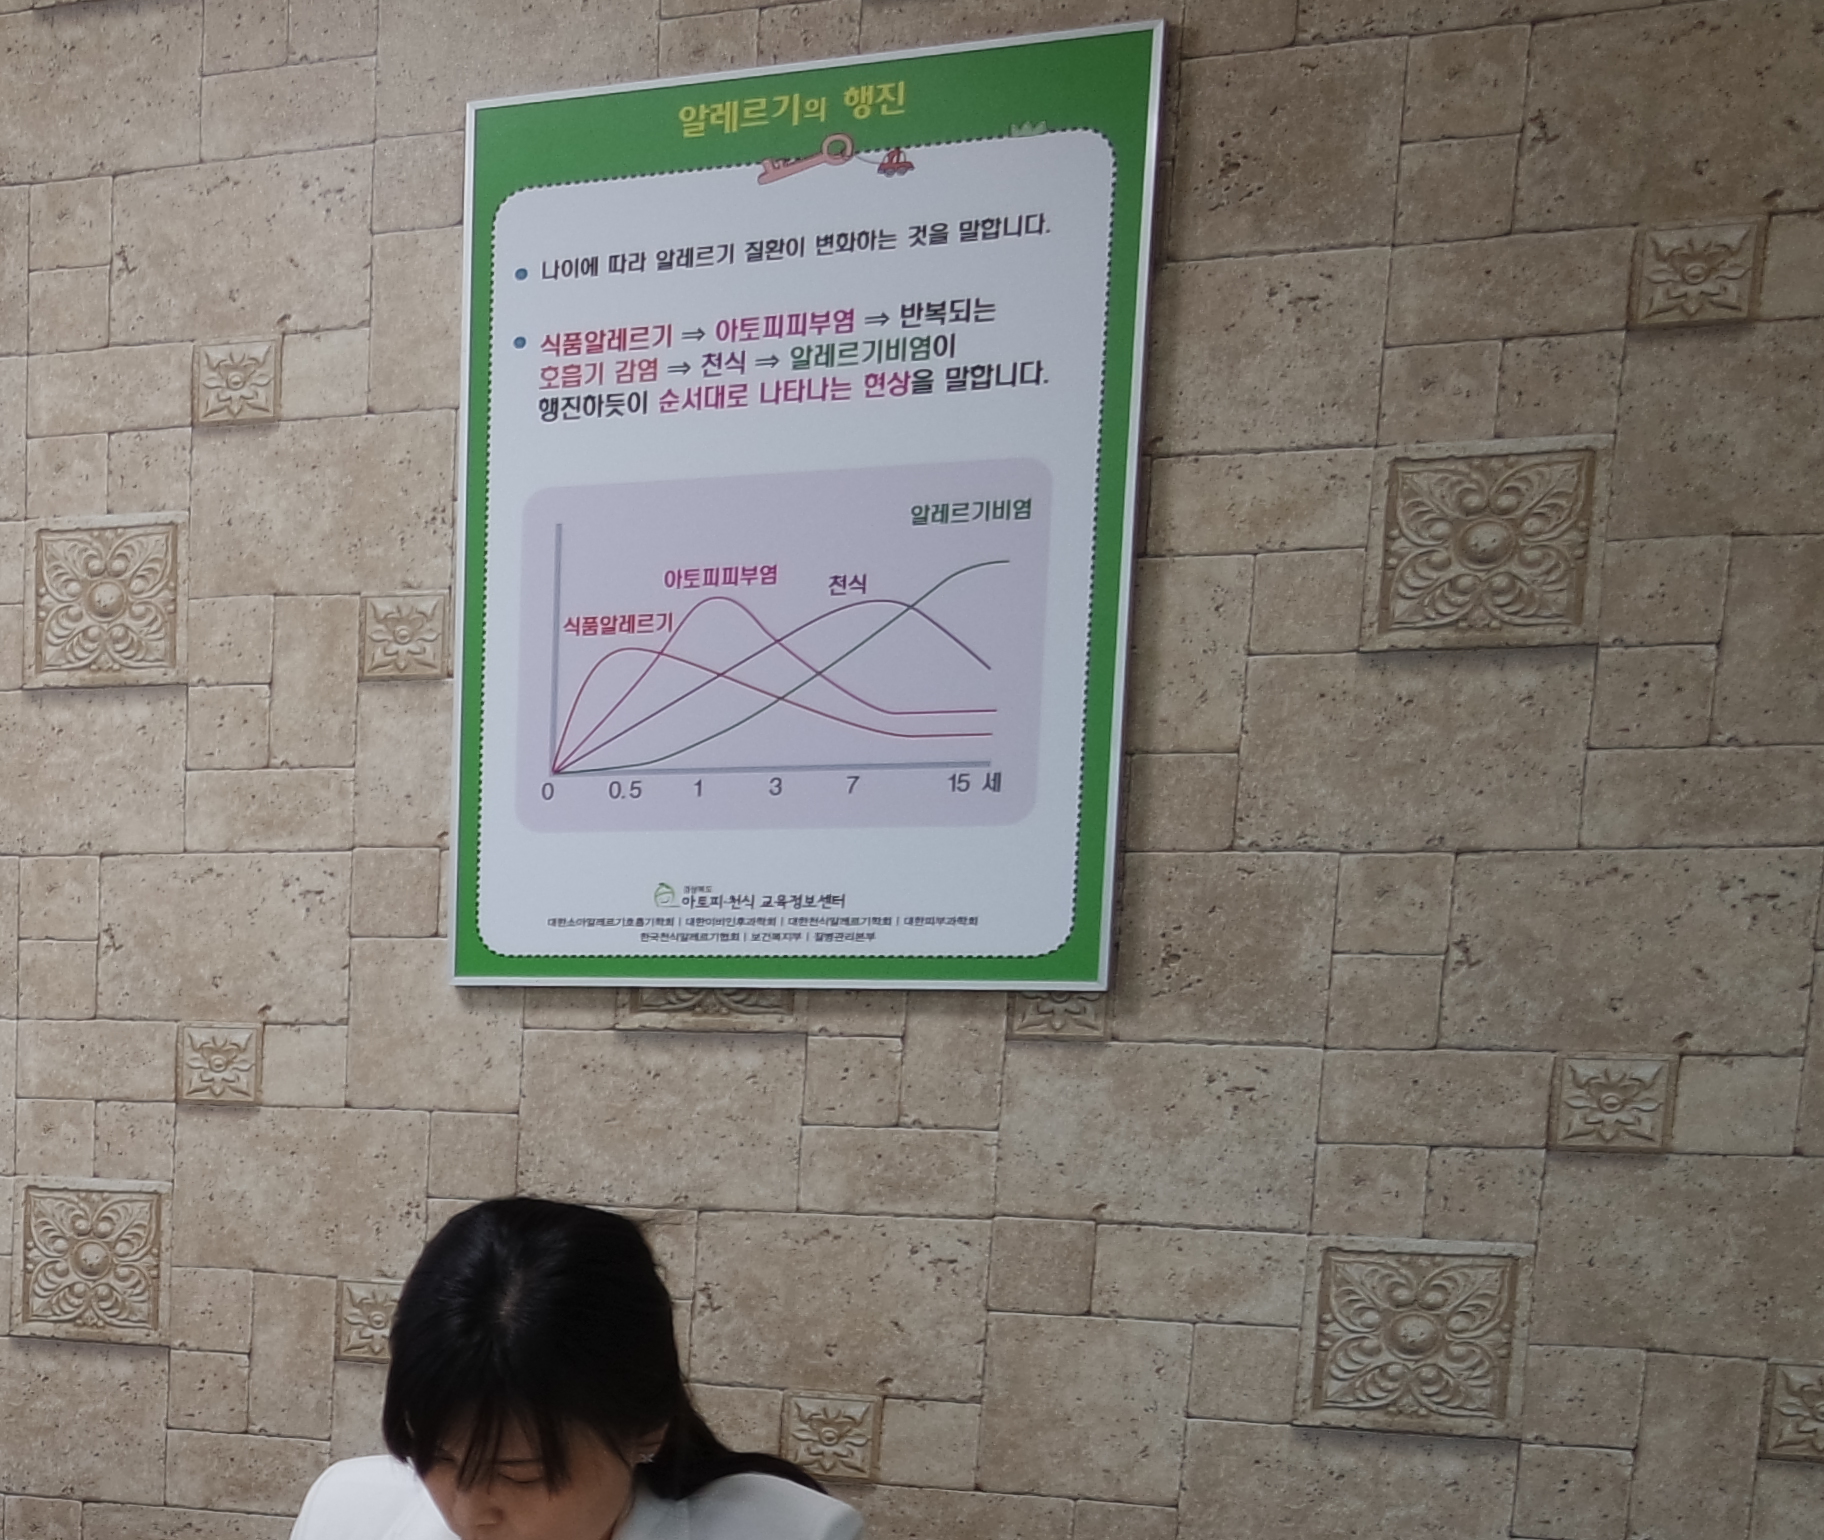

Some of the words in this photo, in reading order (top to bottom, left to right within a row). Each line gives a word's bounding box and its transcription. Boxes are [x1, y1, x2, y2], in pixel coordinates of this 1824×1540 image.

[678, 98, 828, 139] 알레르기의
[843, 81, 907, 119] 행진
[542, 256, 598, 280] 나이에
[609, 252, 646, 274] 따라
[656, 243, 734, 270] 알레르기
[745, 236, 804, 262] 질환이
[816, 229, 897, 255] 변화하는
[909, 223, 949, 247] 것을
[960, 213, 1050, 242] 말합니다.
[539, 324, 674, 357] 식품알레르기
[715, 310, 856, 344] 아토피피부염
[901, 298, 996, 328] 반복되는
[538, 361, 607, 390] 호흡기
[616, 358, 657, 384] 감염
[701, 350, 745, 377] 천식
[790, 334, 957, 372] 알레르기비염이
[539, 391, 647, 422] 행진하듯이
[659, 384, 748, 413] 순서대로
[760, 377, 851, 405] 나타나는
[865, 369, 934, 398] 현상을
[946, 360, 1048, 392] 말합니다.
[911, 498, 1032, 525] 알레르기비염
[665, 564, 777, 589] 아토피피부염
[829, 574, 866, 596] 천식
[563, 613, 674, 636] 식품알레르기
[542, 780, 554, 800] 0
[609, 781, 642, 799] 0.5
[694, 779, 702, 797] 1
[769, 777, 782, 796] 3
[847, 776, 860, 794] 7
[948, 773, 970, 792] 15
[982, 772, 1001, 792] 세
[760, 894, 845, 909] 교육정보센터
